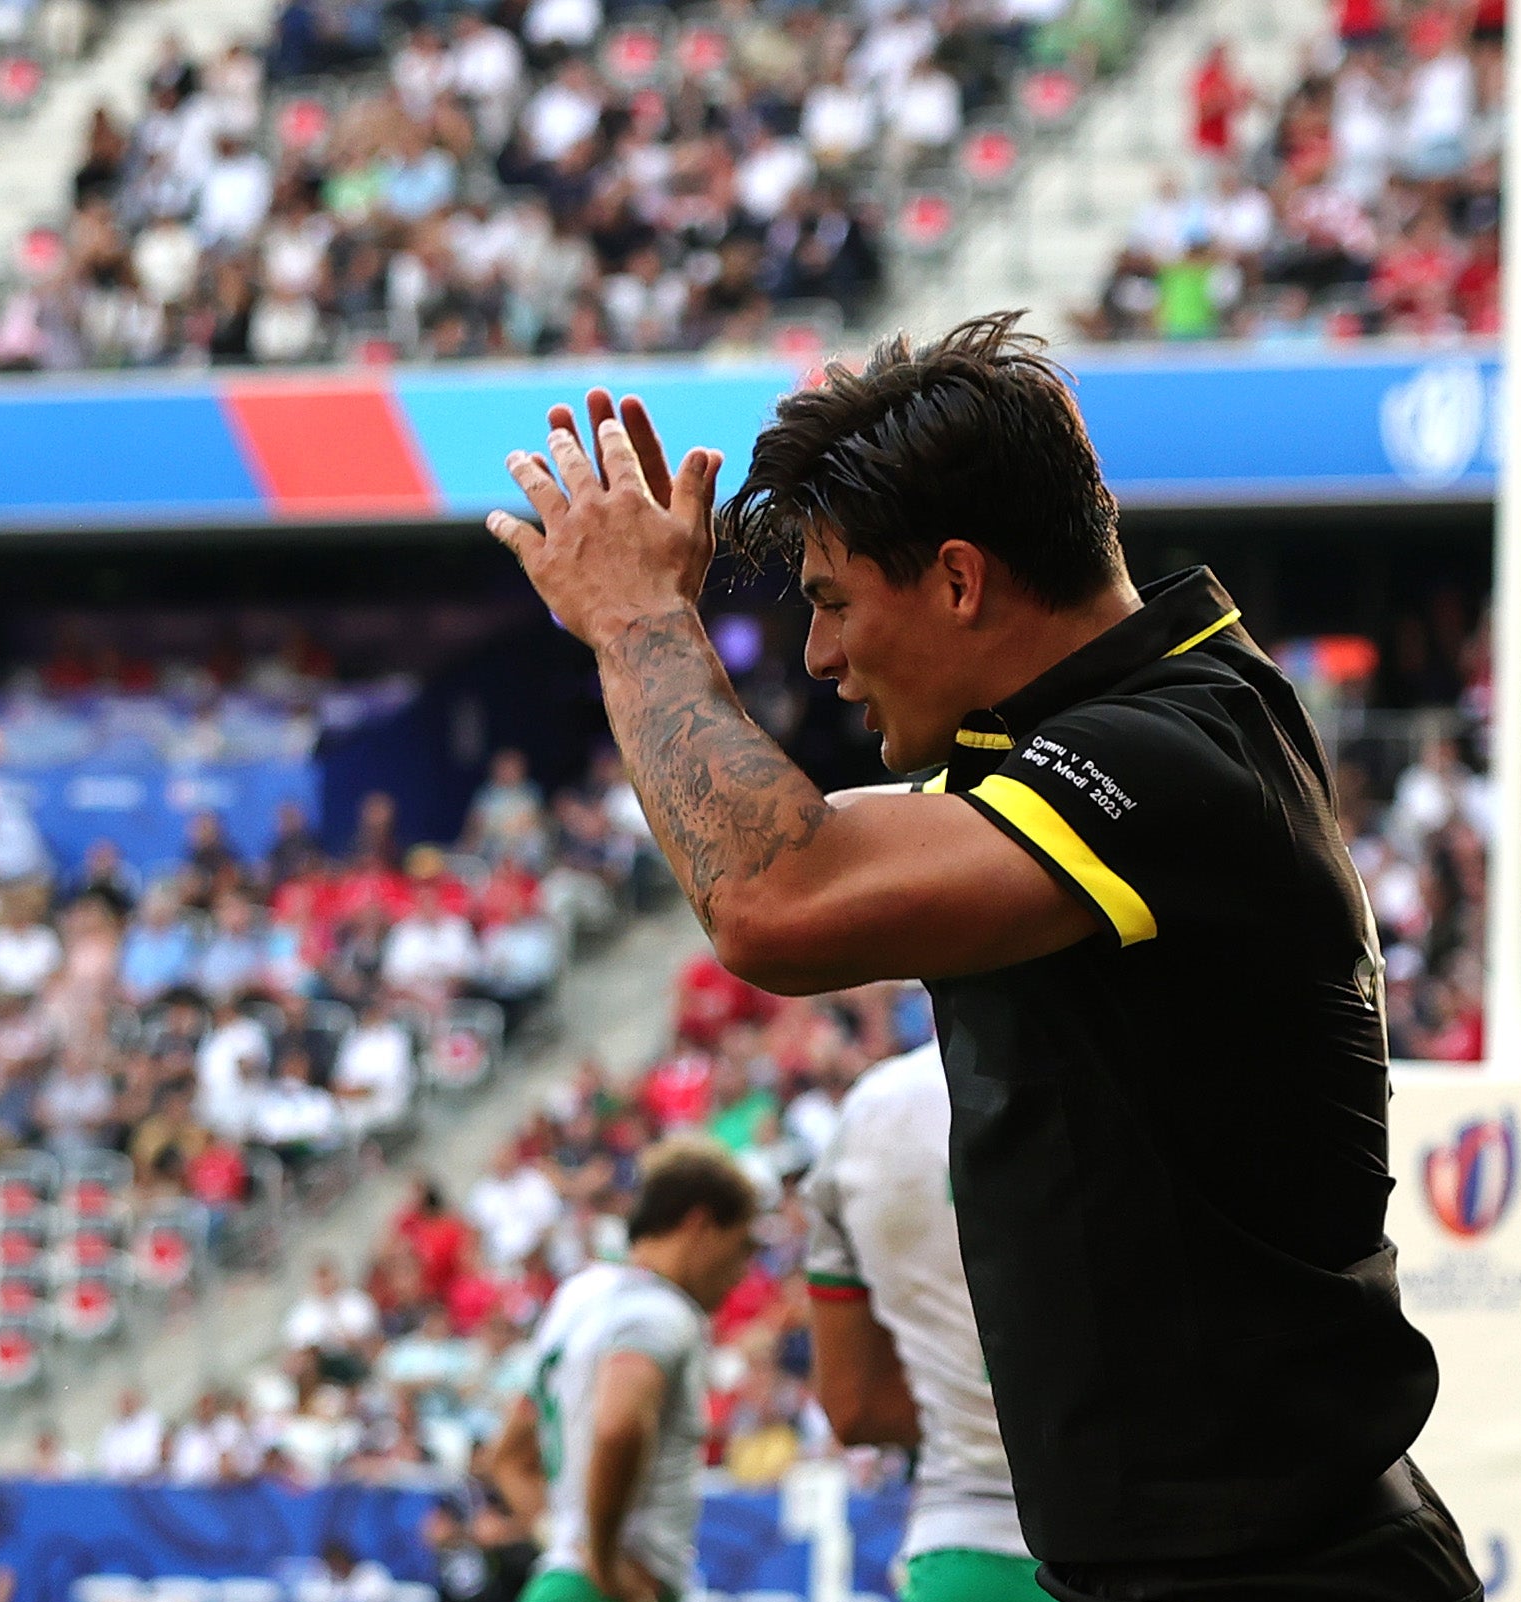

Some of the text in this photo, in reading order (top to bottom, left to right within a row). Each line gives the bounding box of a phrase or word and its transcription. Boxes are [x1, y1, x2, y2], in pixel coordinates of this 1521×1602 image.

[1032, 735, 1138, 810] Cymru v Portigwal
[1052, 760, 1089, 789] Medi
[1089, 788, 1122, 820] 2023
